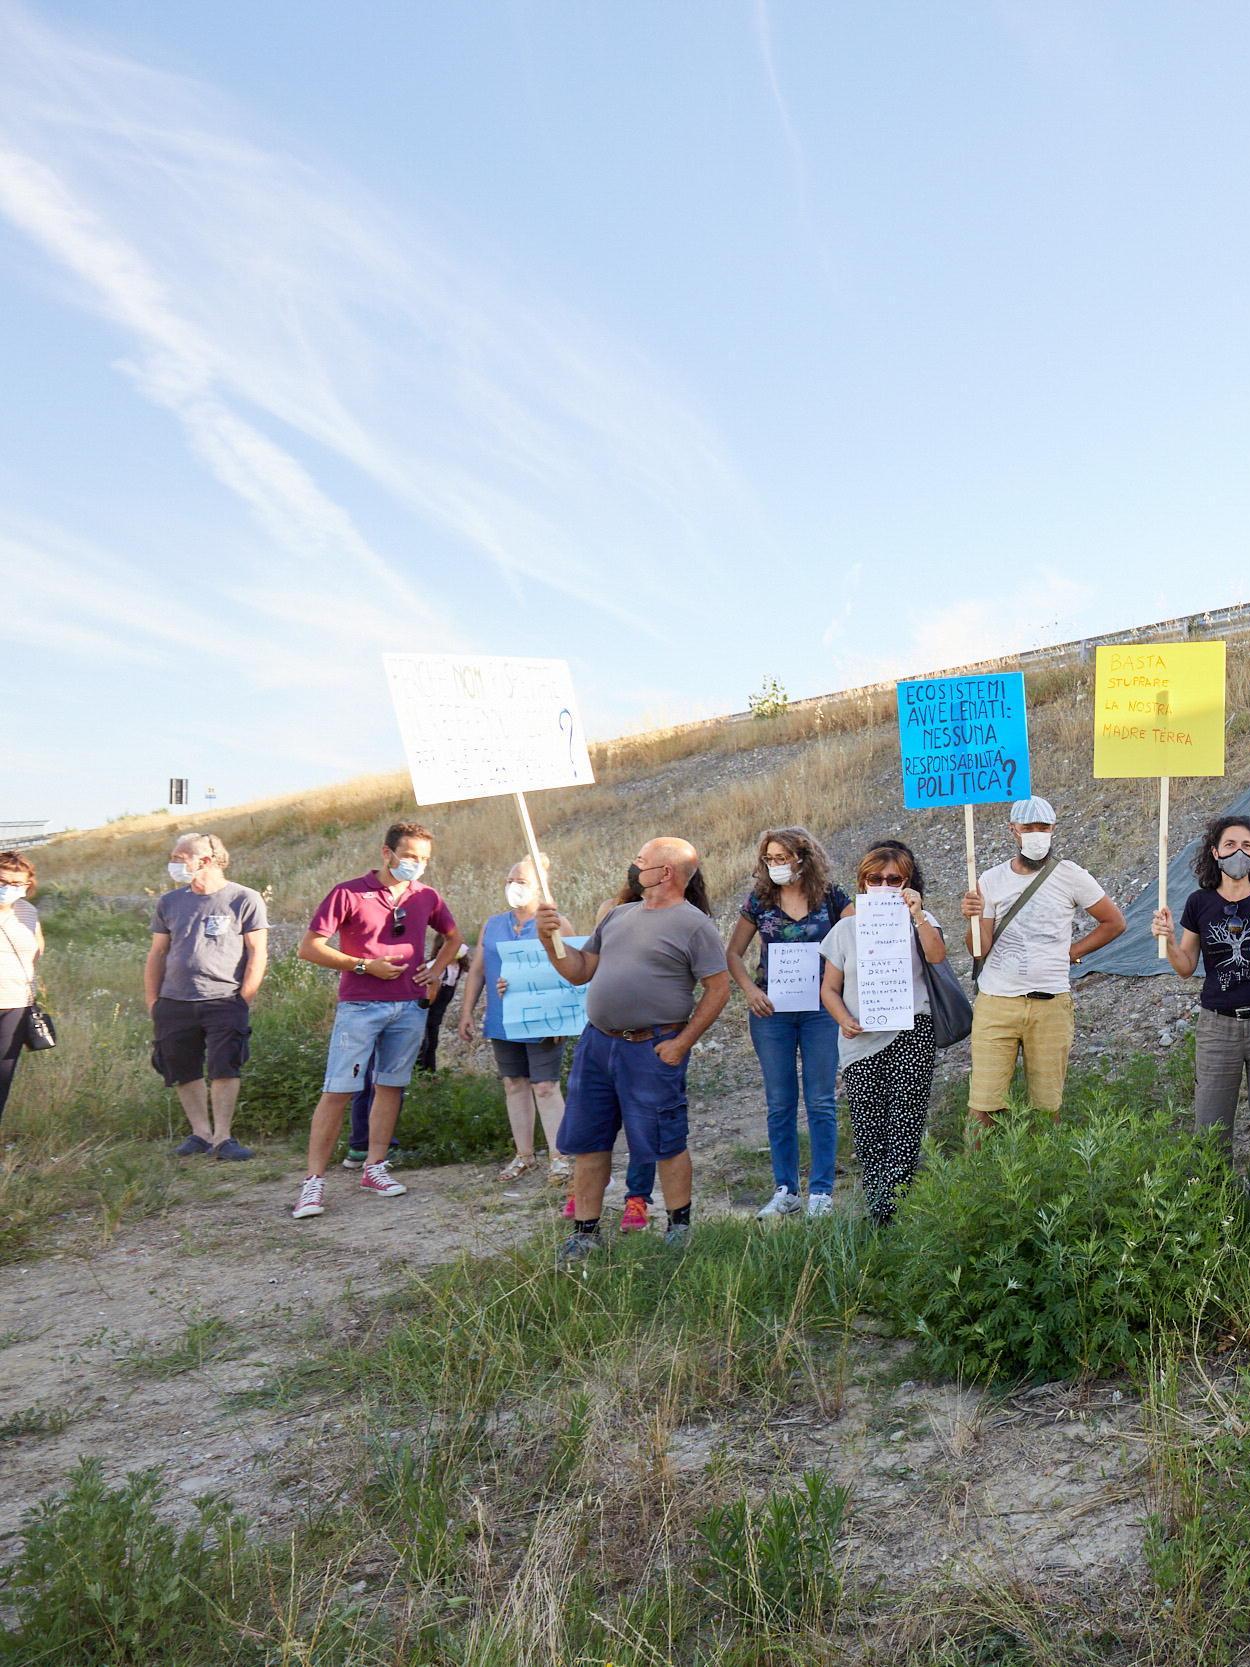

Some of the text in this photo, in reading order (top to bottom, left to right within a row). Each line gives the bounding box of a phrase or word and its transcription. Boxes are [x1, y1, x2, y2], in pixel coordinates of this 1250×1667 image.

[1110, 653, 1167, 672] BASTA
[906, 679, 1006, 705] ECOSISTEMI
[906, 699, 1012, 728] AVVELENATI:
[1104, 699, 1173, 716] LA NOSTRA
[922, 723, 998, 750] NESSUNA
[1102, 723, 1193, 746] MADRE TERRA
